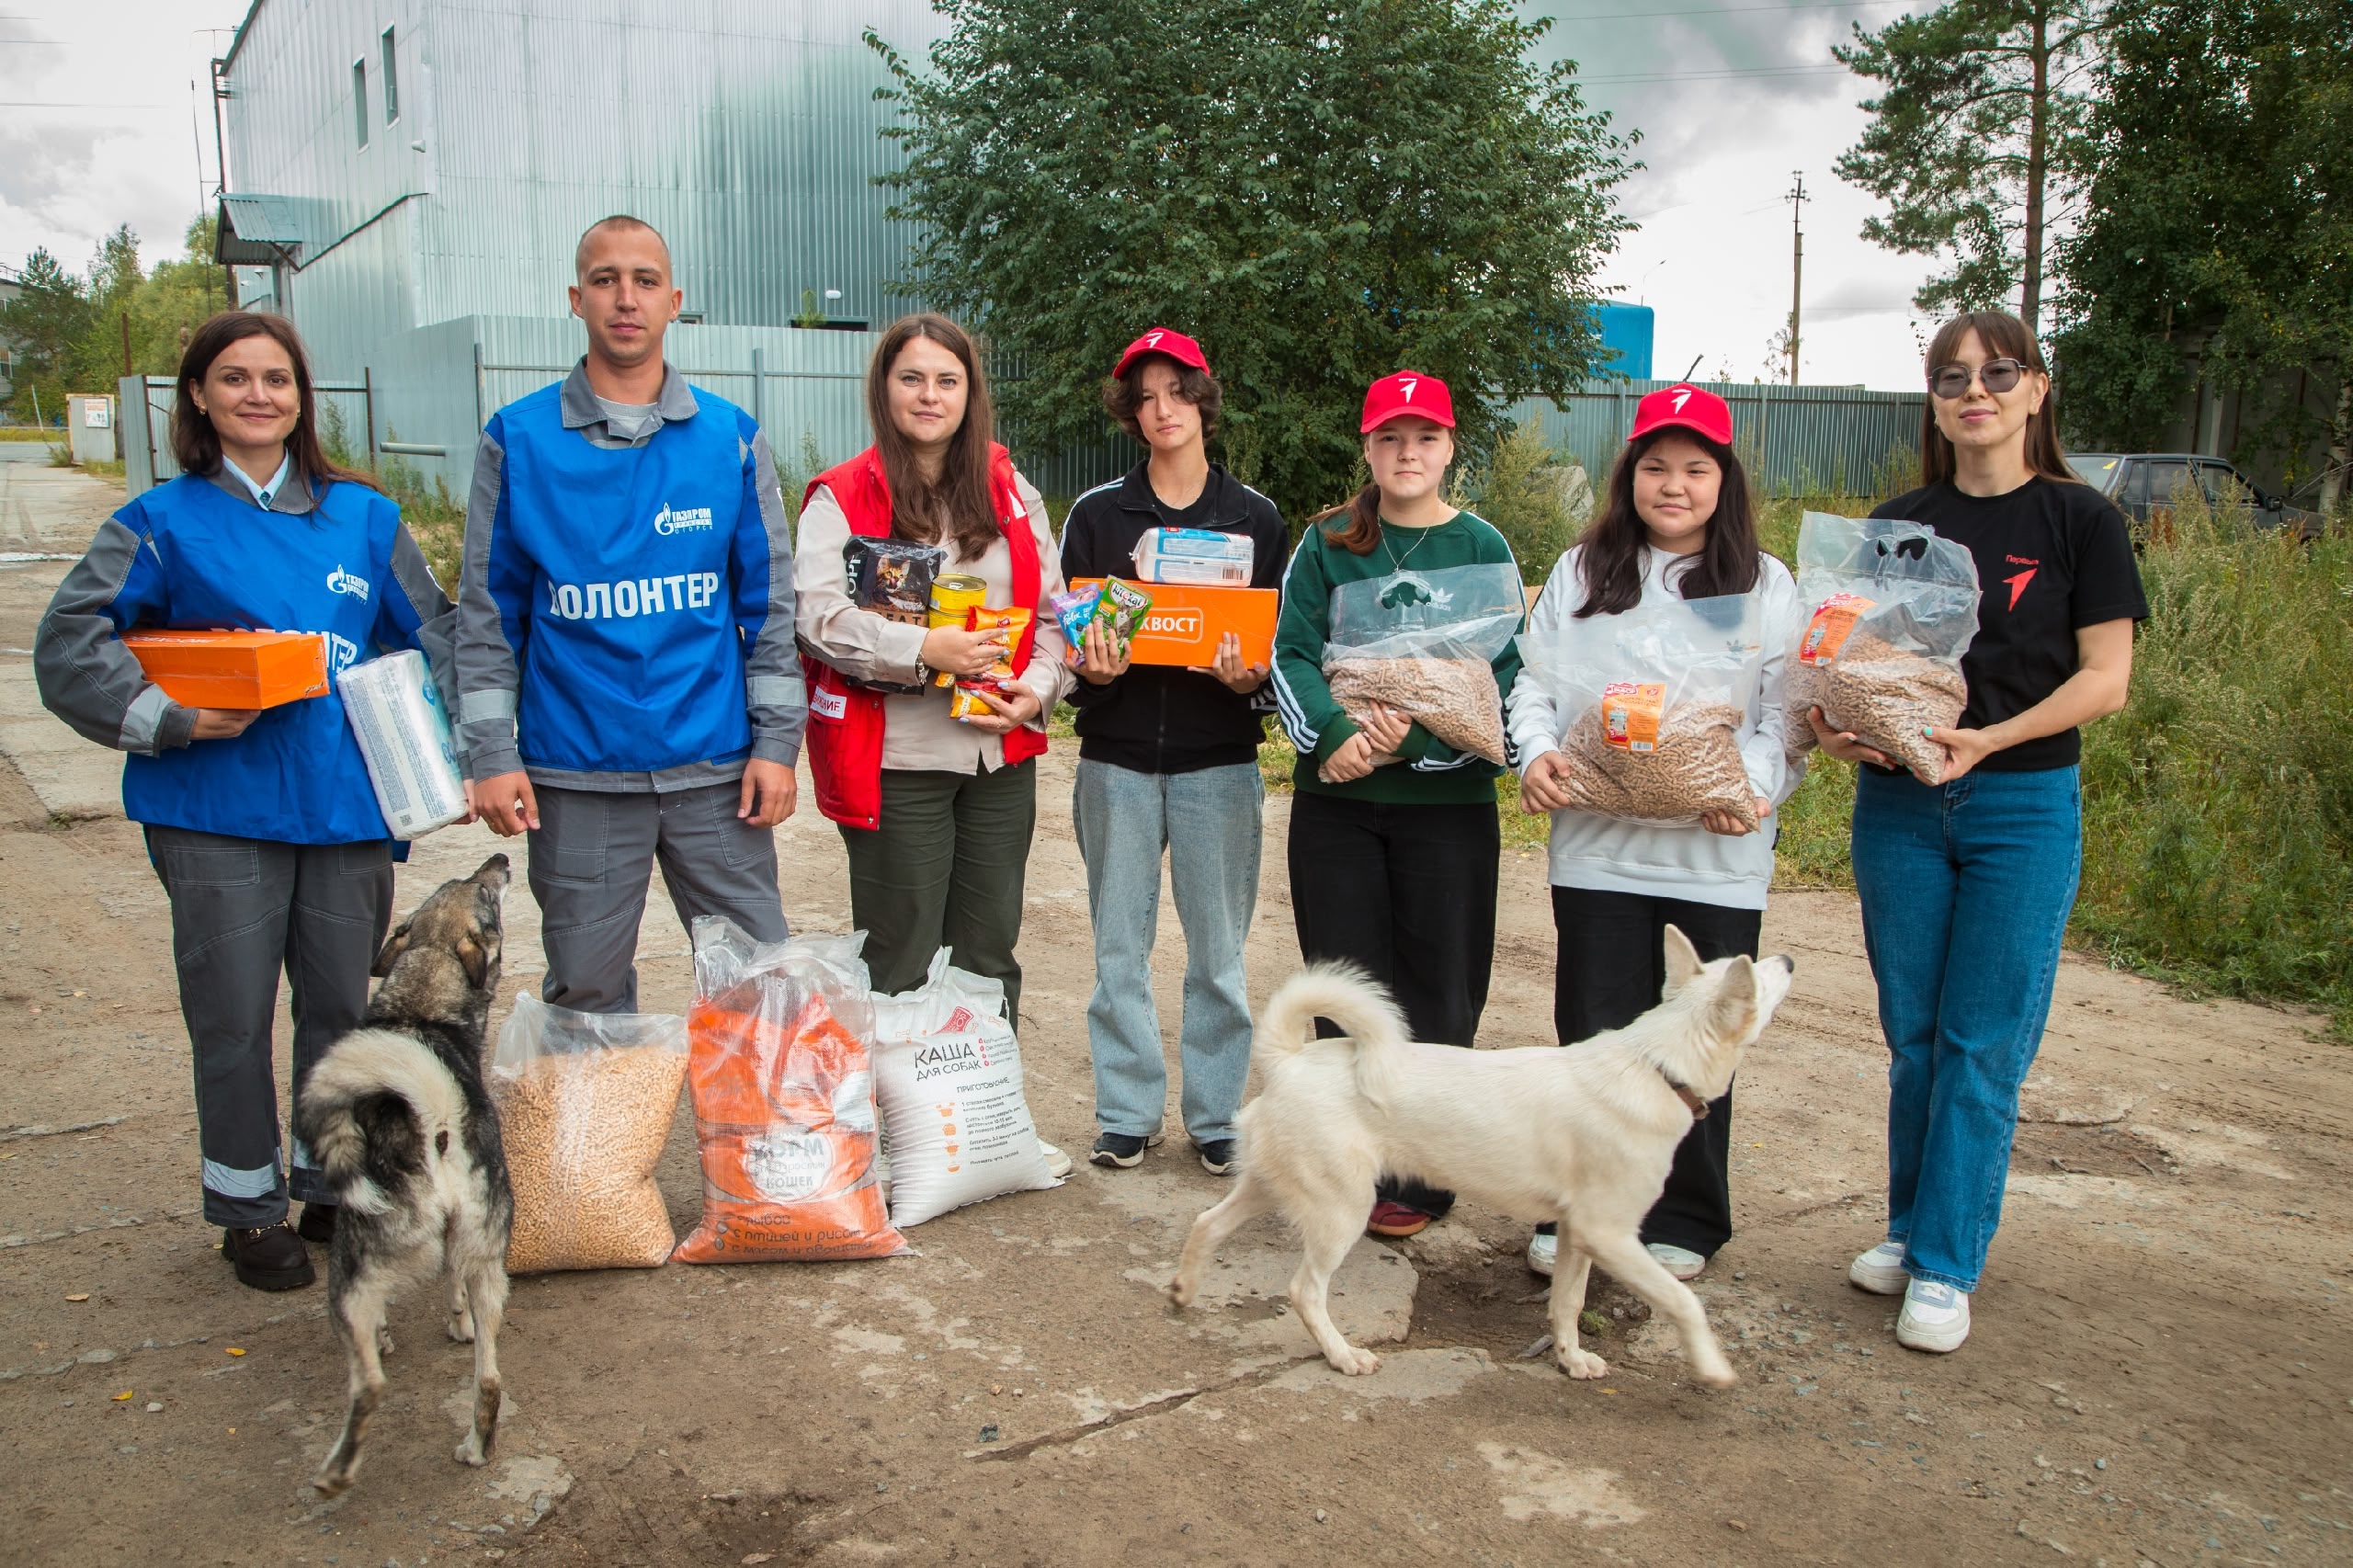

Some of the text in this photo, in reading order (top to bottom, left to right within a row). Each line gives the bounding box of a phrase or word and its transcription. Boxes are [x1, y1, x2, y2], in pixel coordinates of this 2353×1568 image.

[672, 508, 712, 523] ГАЗПРОМ
[548, 572, 719, 620] ВОЛОНТЕР
[1139, 617, 1198, 633] ХВОСТ
[914, 1042, 976, 1069] КАША
[916, 1067, 941, 1083] ДЛЯ
[942, 1060, 983, 1074] СОБАК
[745, 1229, 799, 1243] птицей
